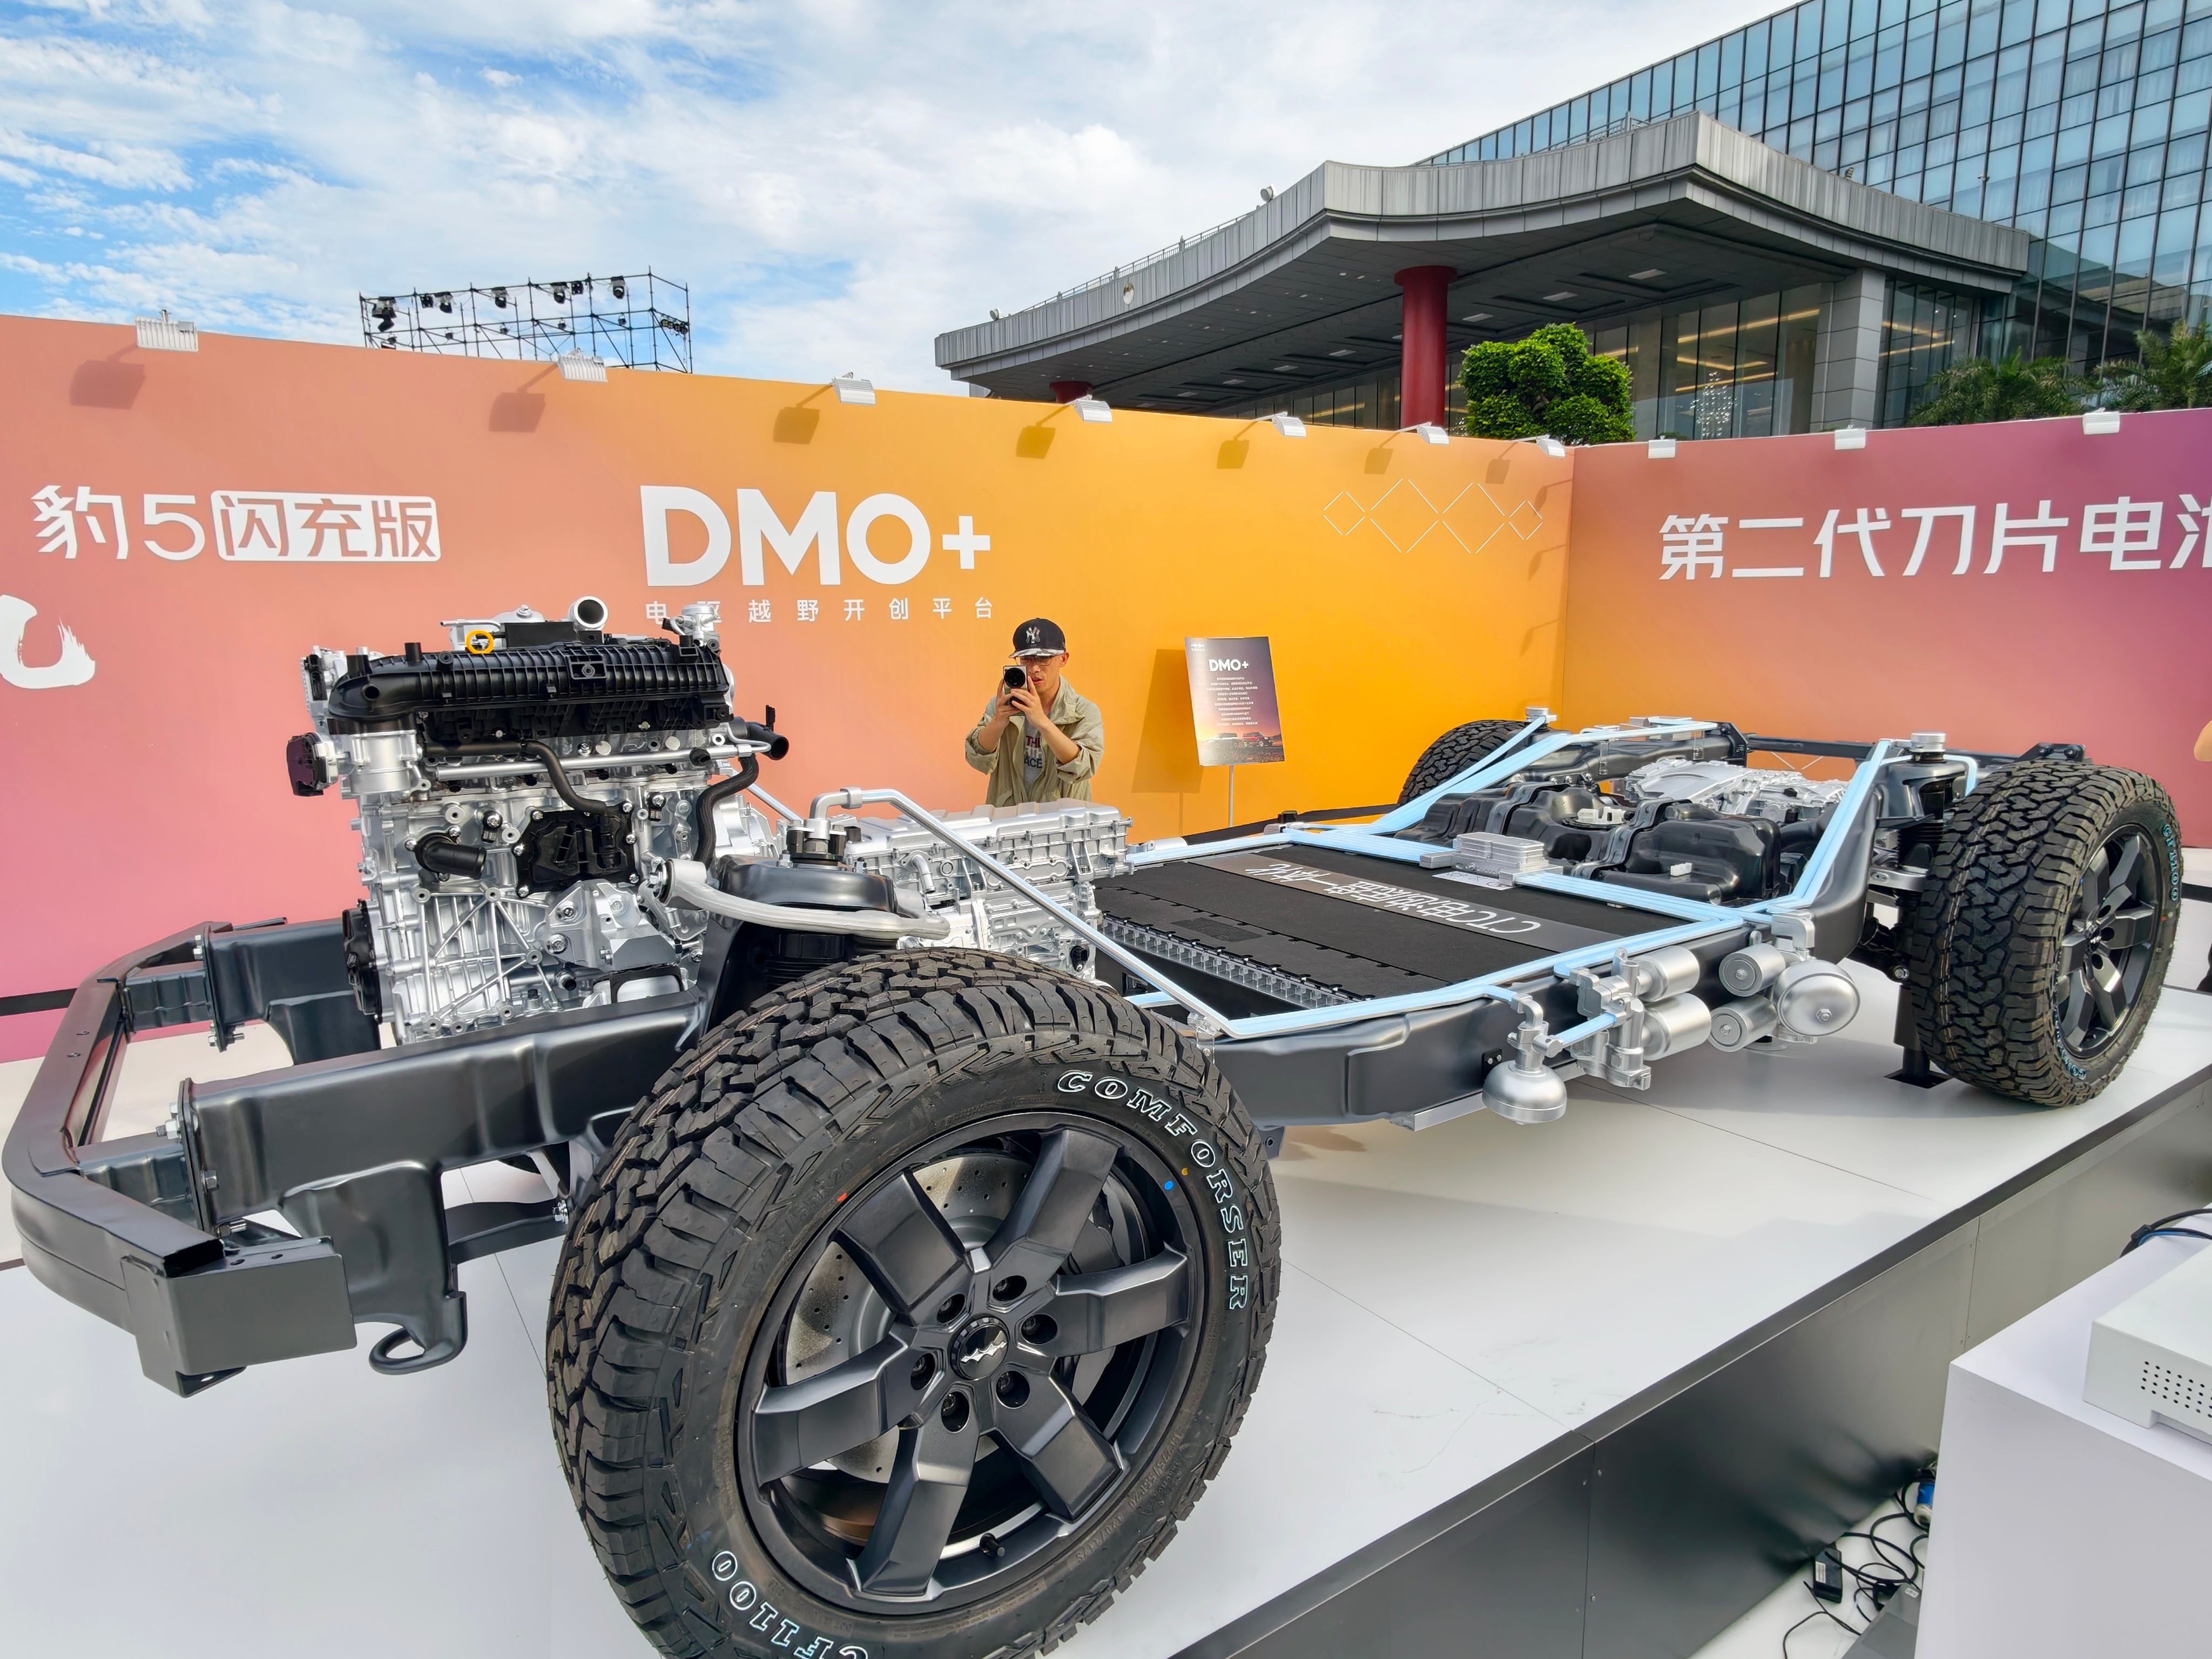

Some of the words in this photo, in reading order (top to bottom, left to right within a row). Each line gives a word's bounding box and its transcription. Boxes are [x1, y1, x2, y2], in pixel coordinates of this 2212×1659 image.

[640, 485, 991, 586] DMO+
[645, 596, 993, 625] 电越野开创平台
[1026, 626, 1041, 644] NY
[1209, 659, 1249, 672] DMO+
[1024, 756, 1043, 768] ACE
[1057, 1069, 1249, 1310] COMFORSER
